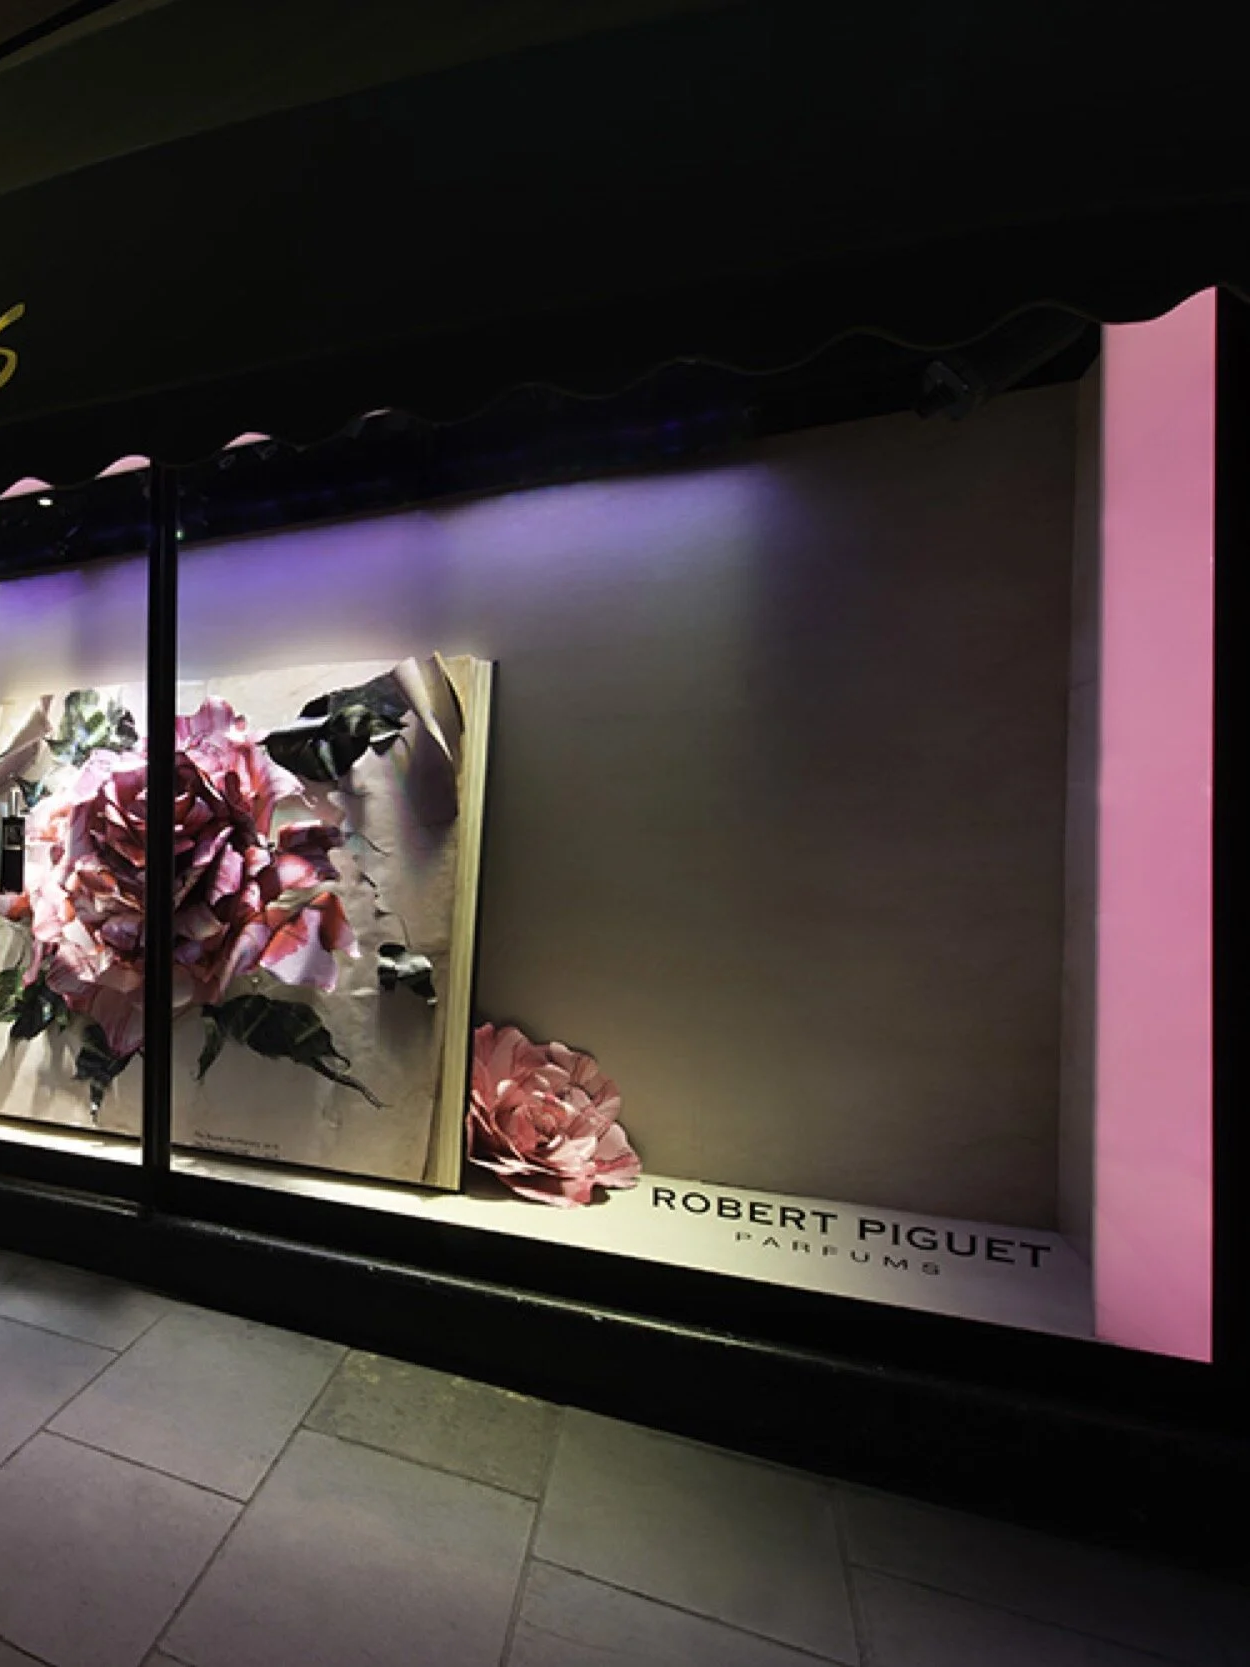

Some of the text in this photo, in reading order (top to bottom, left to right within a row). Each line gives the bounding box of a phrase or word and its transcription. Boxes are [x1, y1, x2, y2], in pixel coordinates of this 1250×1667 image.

[652, 1186, 1051, 1268] ROBERT PIGUET
[735, 1231, 940, 1276] PARFUMS
